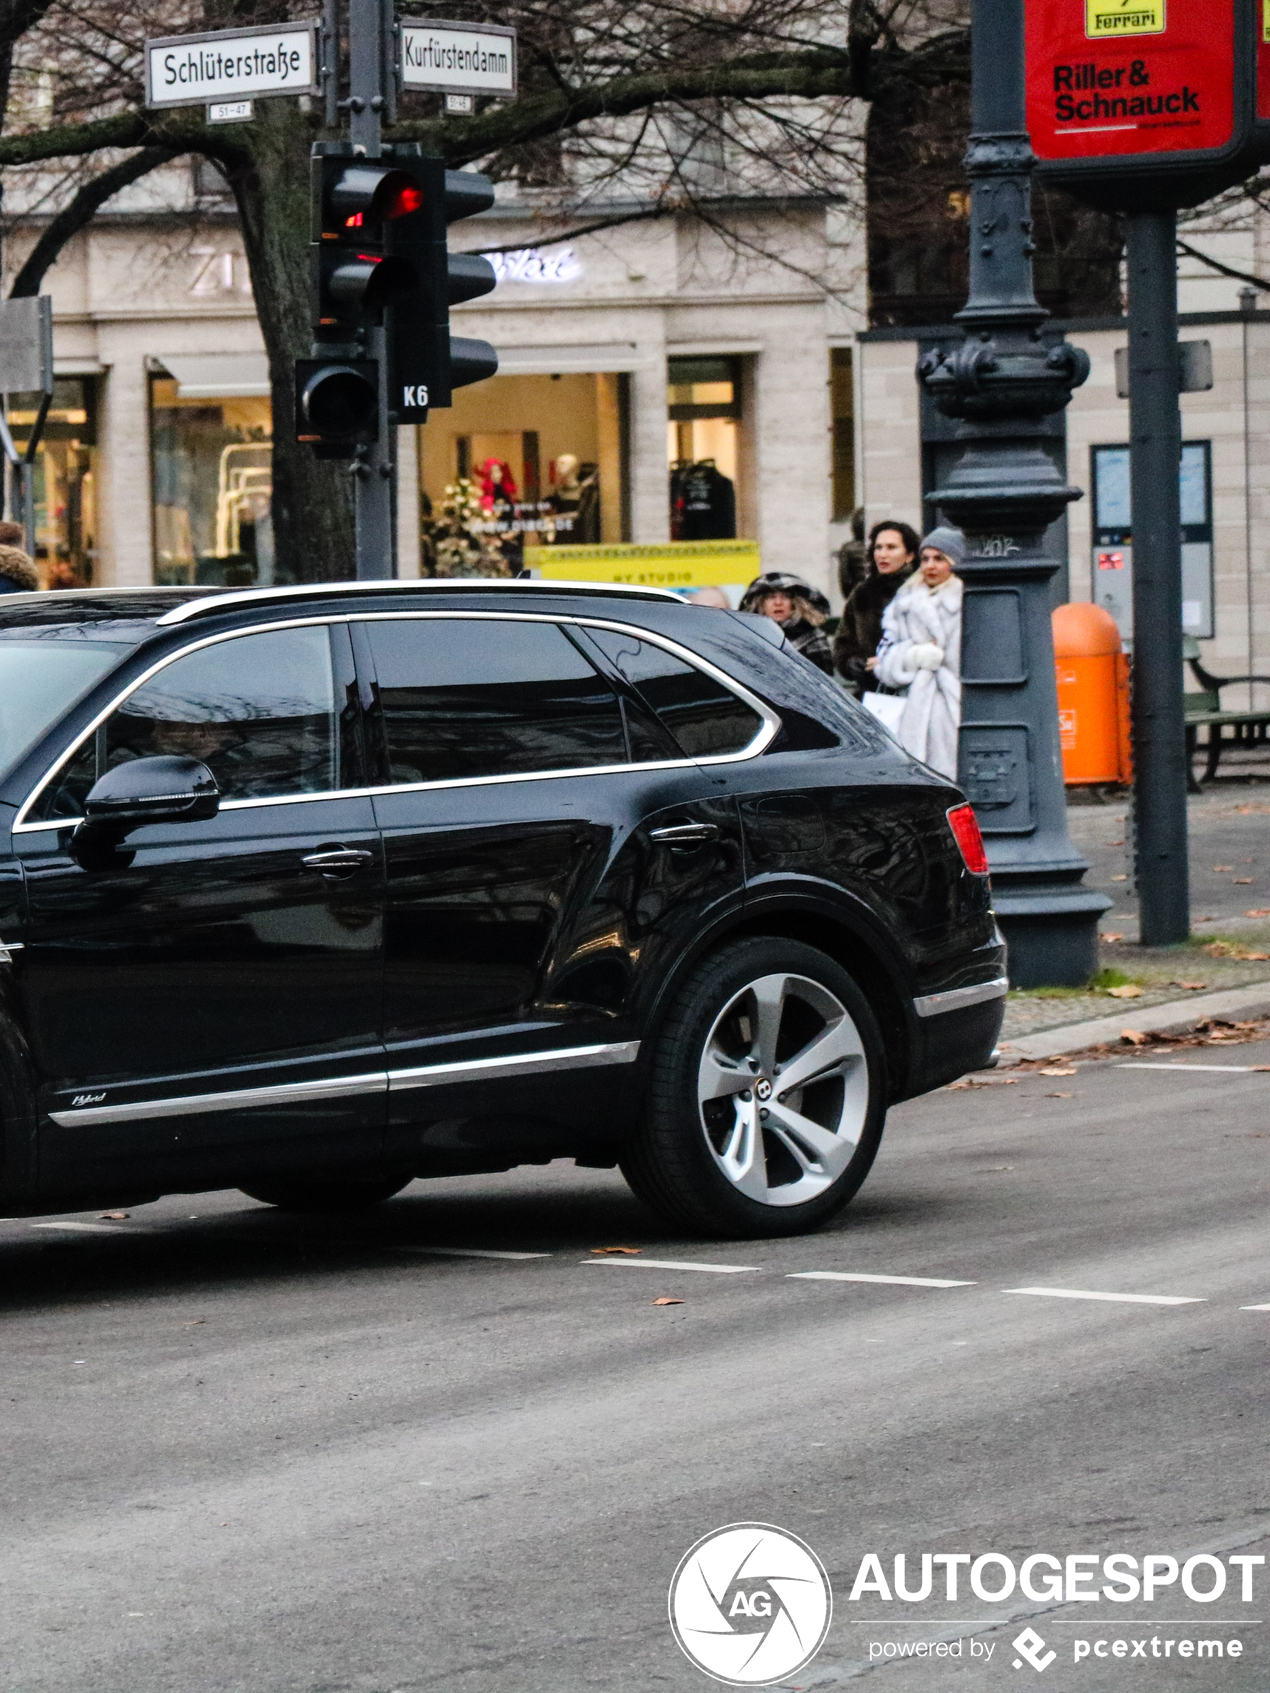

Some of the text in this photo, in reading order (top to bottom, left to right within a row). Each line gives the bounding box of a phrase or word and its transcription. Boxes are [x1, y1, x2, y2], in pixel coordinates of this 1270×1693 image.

[1094, 10, 1155, 30] Ferrari
[164, 43, 300, 85] Schlüterstraße
[404, 35, 508, 74] Kurfürstendamm
[1054, 86, 1200, 122] Schnauck
[403, 384, 429, 407] K6
[638, 572, 692, 583] STUDIO
[71, 1092, 107, 1106] Hybrid
